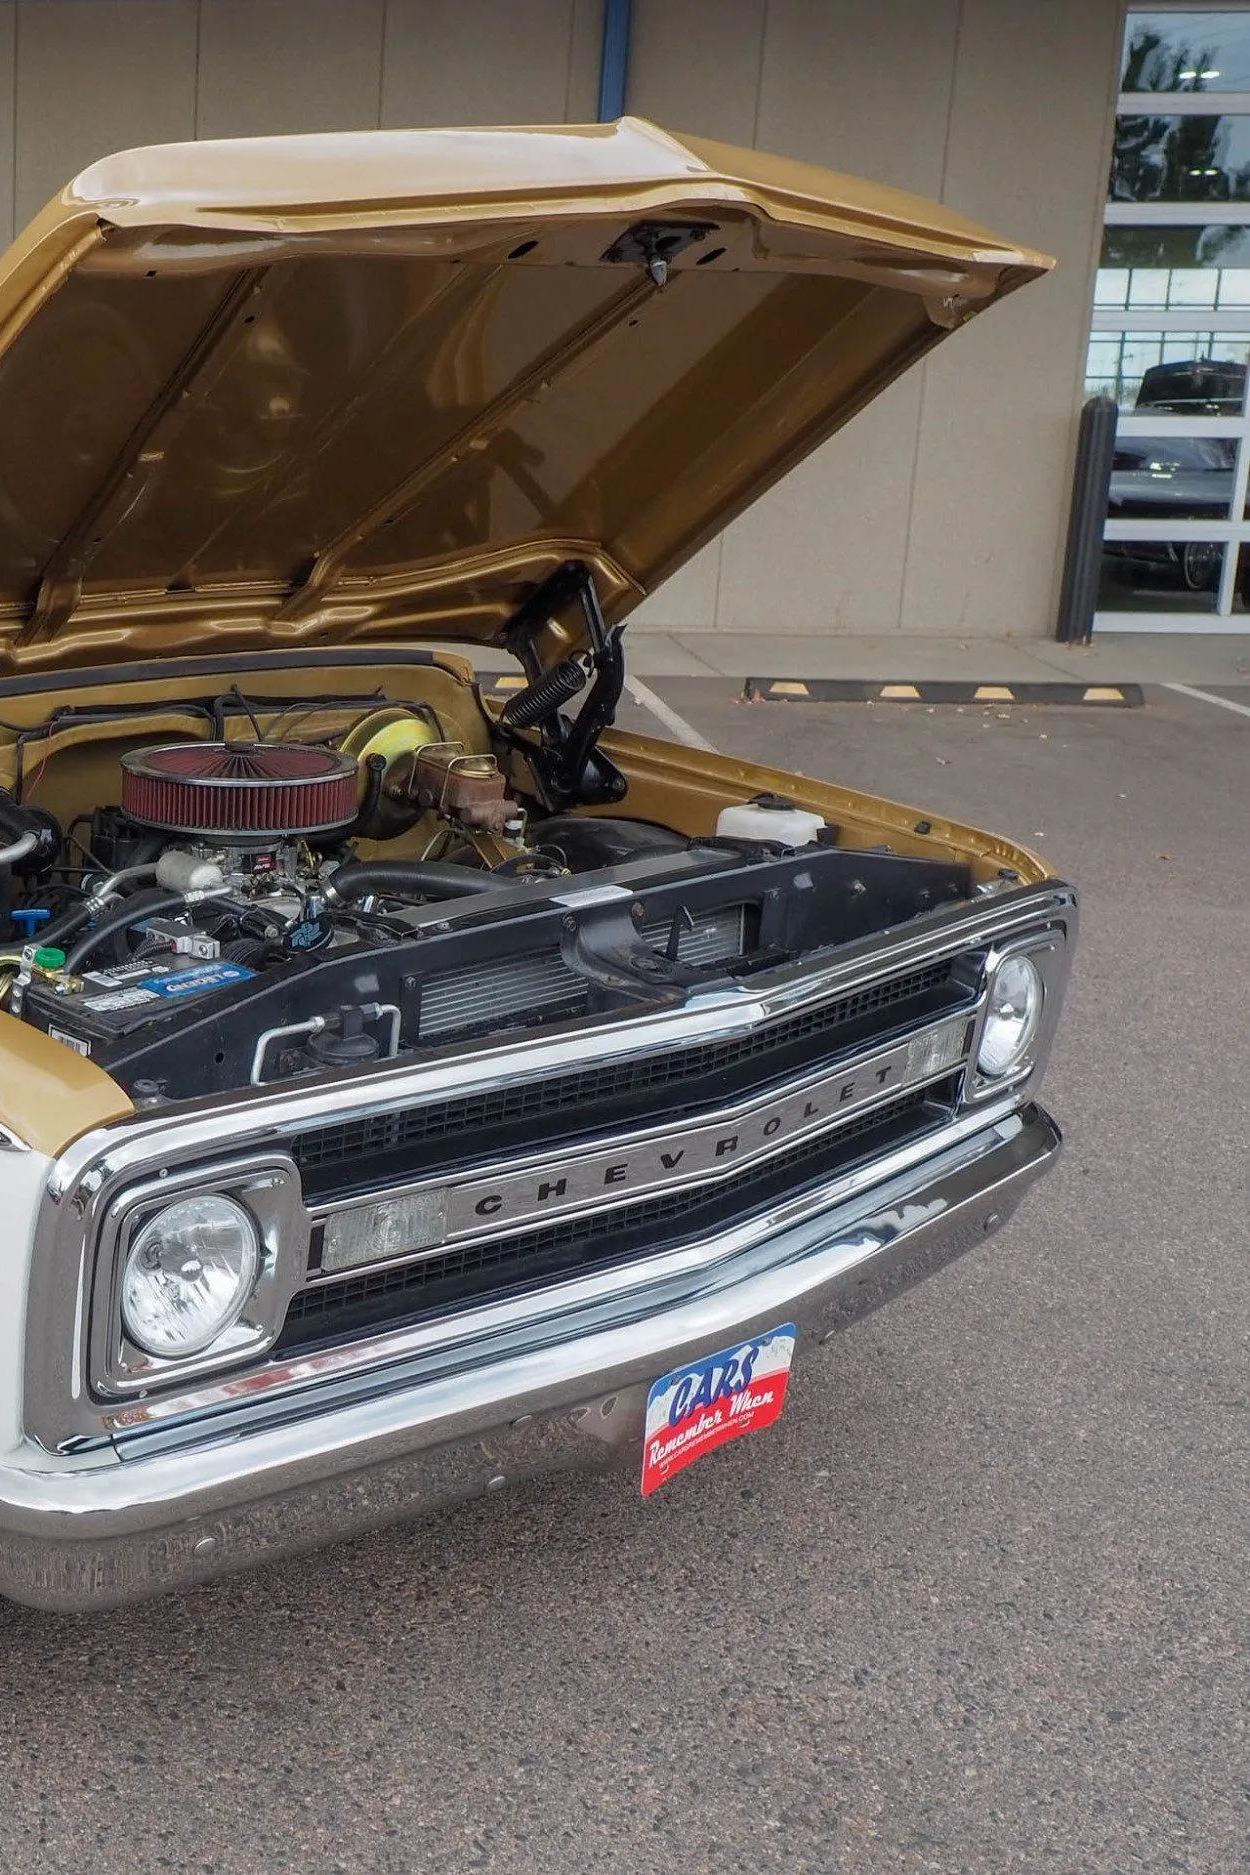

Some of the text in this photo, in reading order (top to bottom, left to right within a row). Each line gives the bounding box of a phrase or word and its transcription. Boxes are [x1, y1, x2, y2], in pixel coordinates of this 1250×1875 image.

[475, 1066, 893, 1216] CHEVROLET
[668, 1346, 760, 1427] CARS
[650, 1410, 723, 1469] Remember
[729, 1390, 774, 1417] When
